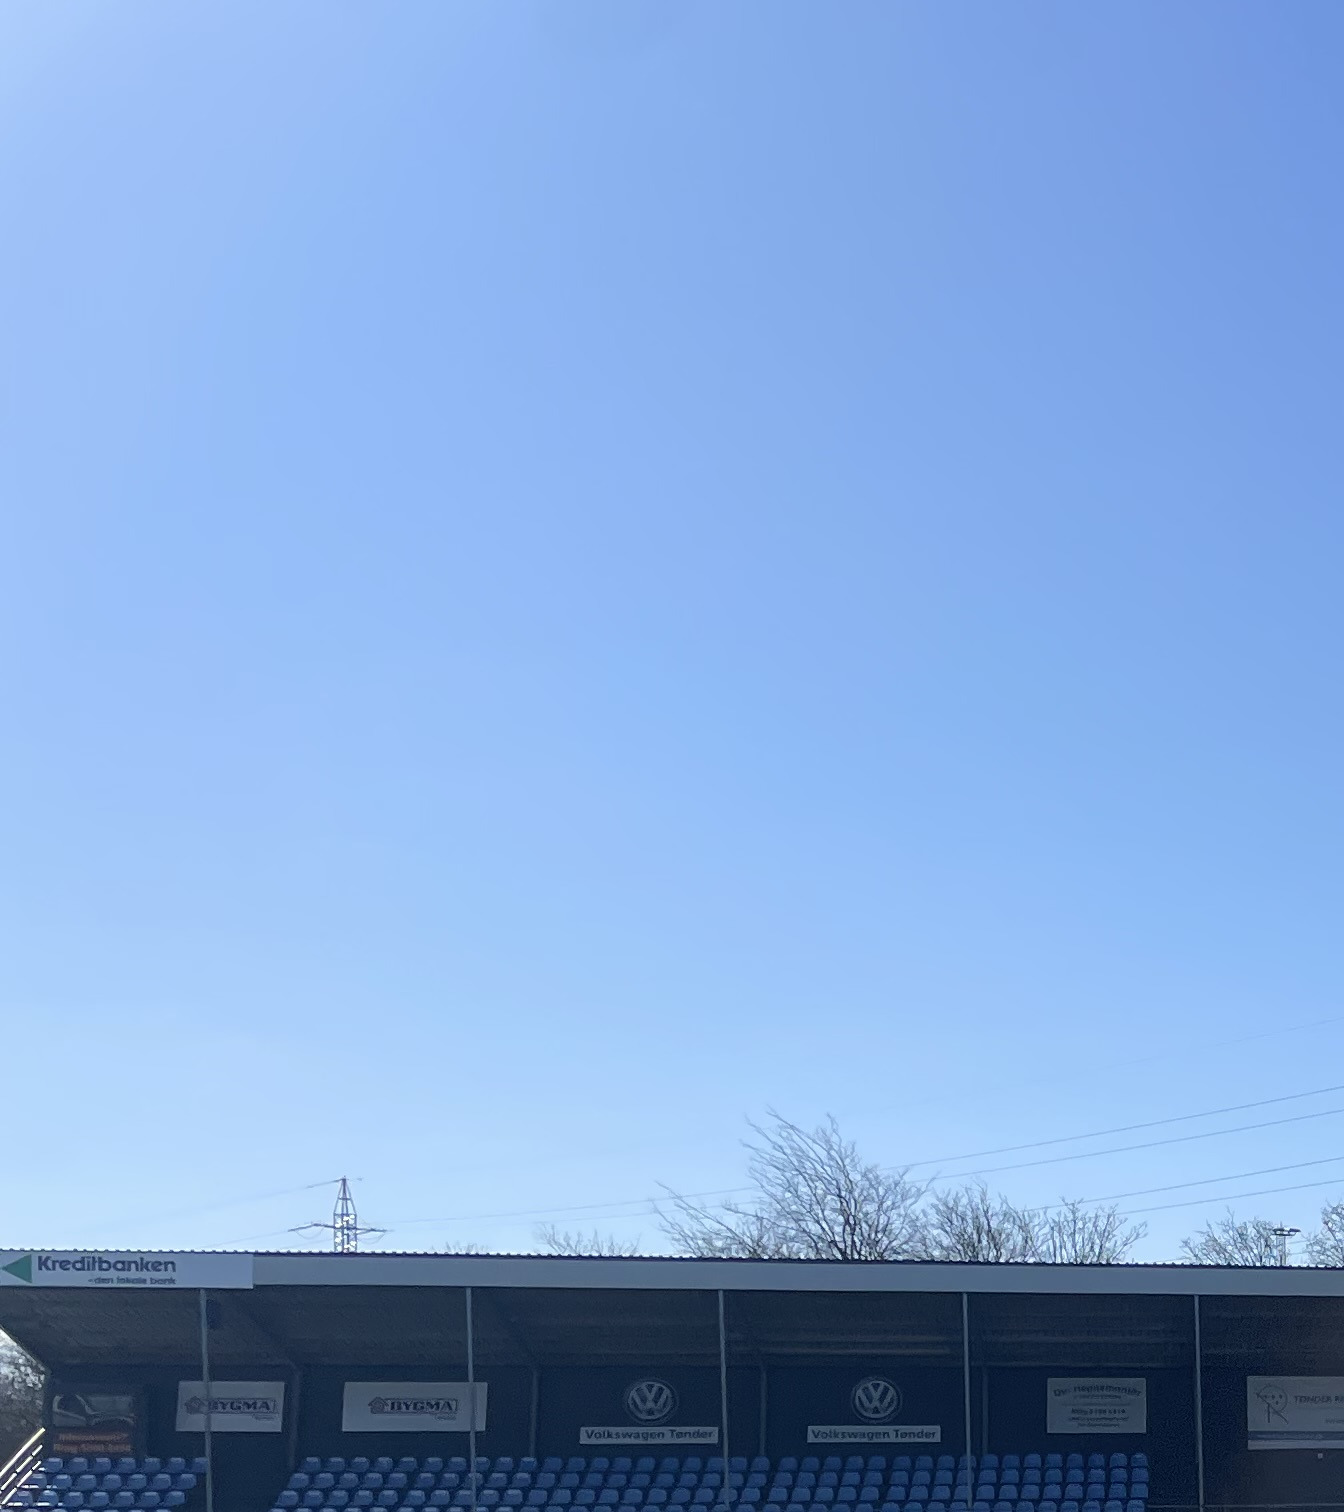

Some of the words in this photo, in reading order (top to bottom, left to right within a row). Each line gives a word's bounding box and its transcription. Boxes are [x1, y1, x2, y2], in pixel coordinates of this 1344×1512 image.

[37, 1255, 177, 1273] Kreditbanken
[390, 1400, 453, 1411] BYGMA
[585, 1428, 666, 1441] Volkswagen
[668, 1428, 714, 1440] Tønder
[812, 1428, 890, 1440] Volkswagen
[892, 1428, 937, 1440] Tønder
